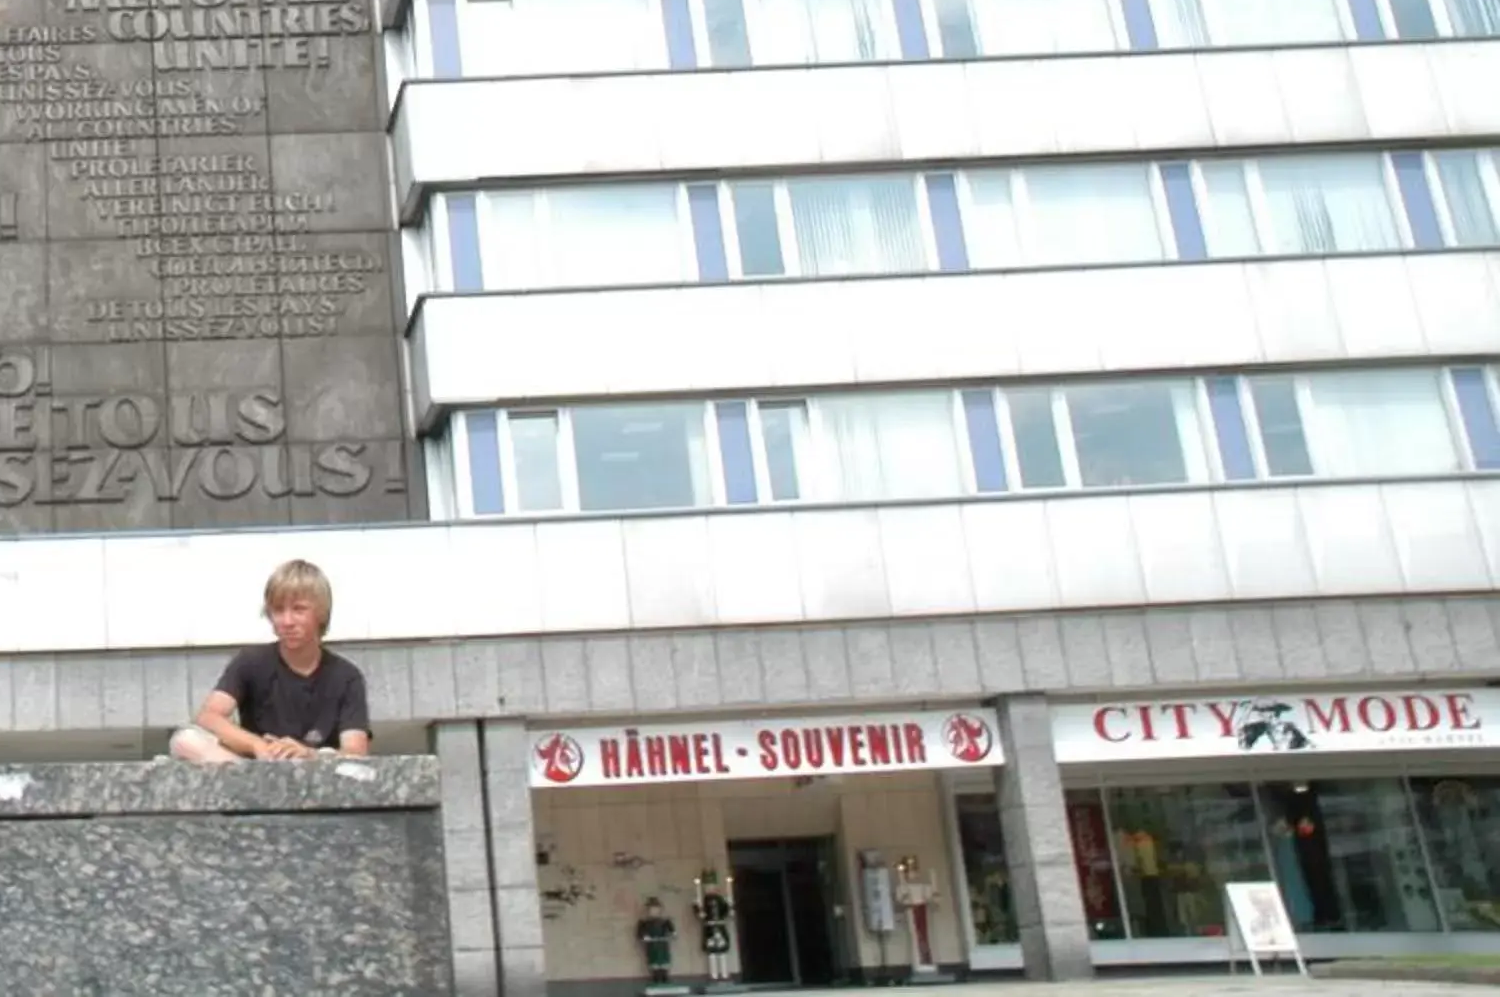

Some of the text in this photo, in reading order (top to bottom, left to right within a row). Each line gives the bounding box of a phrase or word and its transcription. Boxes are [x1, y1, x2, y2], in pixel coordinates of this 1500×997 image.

[152, 36, 331, 71] UNITE!
[71, 154, 257, 179] PROLETARIER
[48, 390, 288, 453] TOUS
[1092, 692, 1483, 743] CITY MODE
[599, 722, 928, 779] HÄHNEL SOUVENIR
